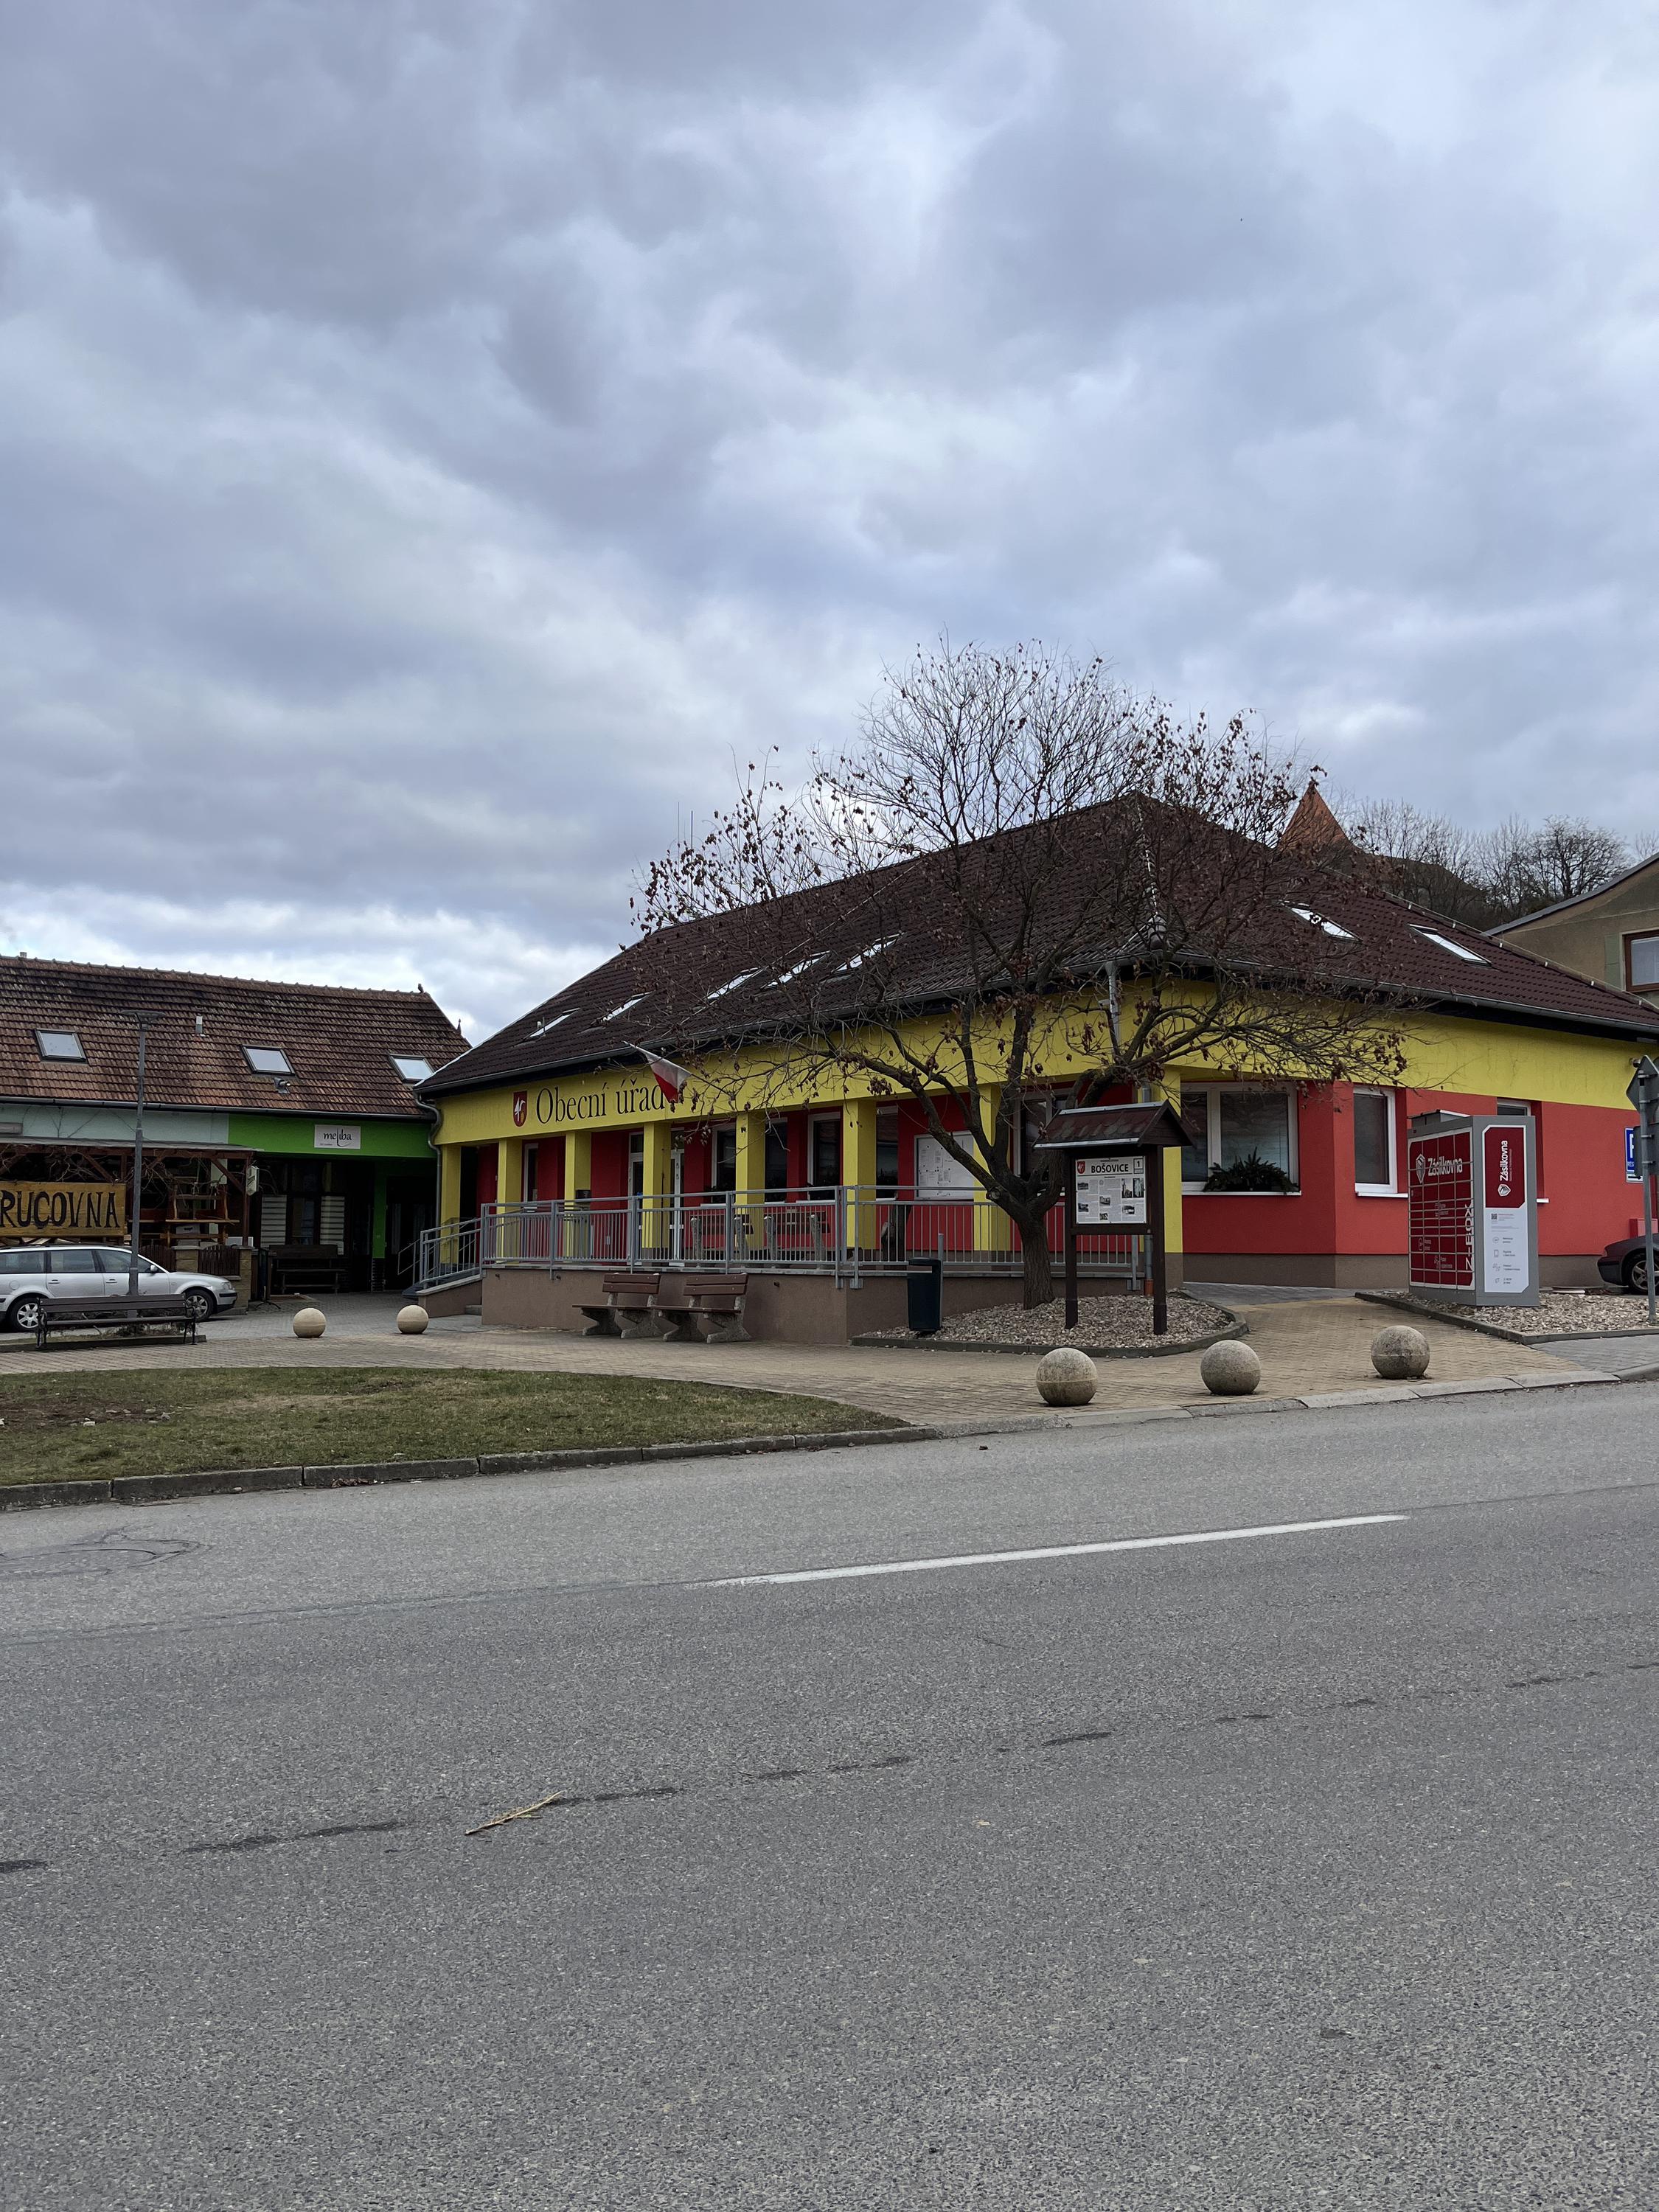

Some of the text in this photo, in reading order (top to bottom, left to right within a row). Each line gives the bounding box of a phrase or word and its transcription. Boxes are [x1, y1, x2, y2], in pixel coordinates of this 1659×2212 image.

[536, 1077, 665, 1124] Obecní úřad
[1091, 1163, 1129, 1173] BOŠOVICE
[1427, 1156, 1463, 1176] Zásilkovna
[1500, 1140, 1509, 1181] Zásilkovna
[1465, 1203, 1473, 1270] Z-BOX
